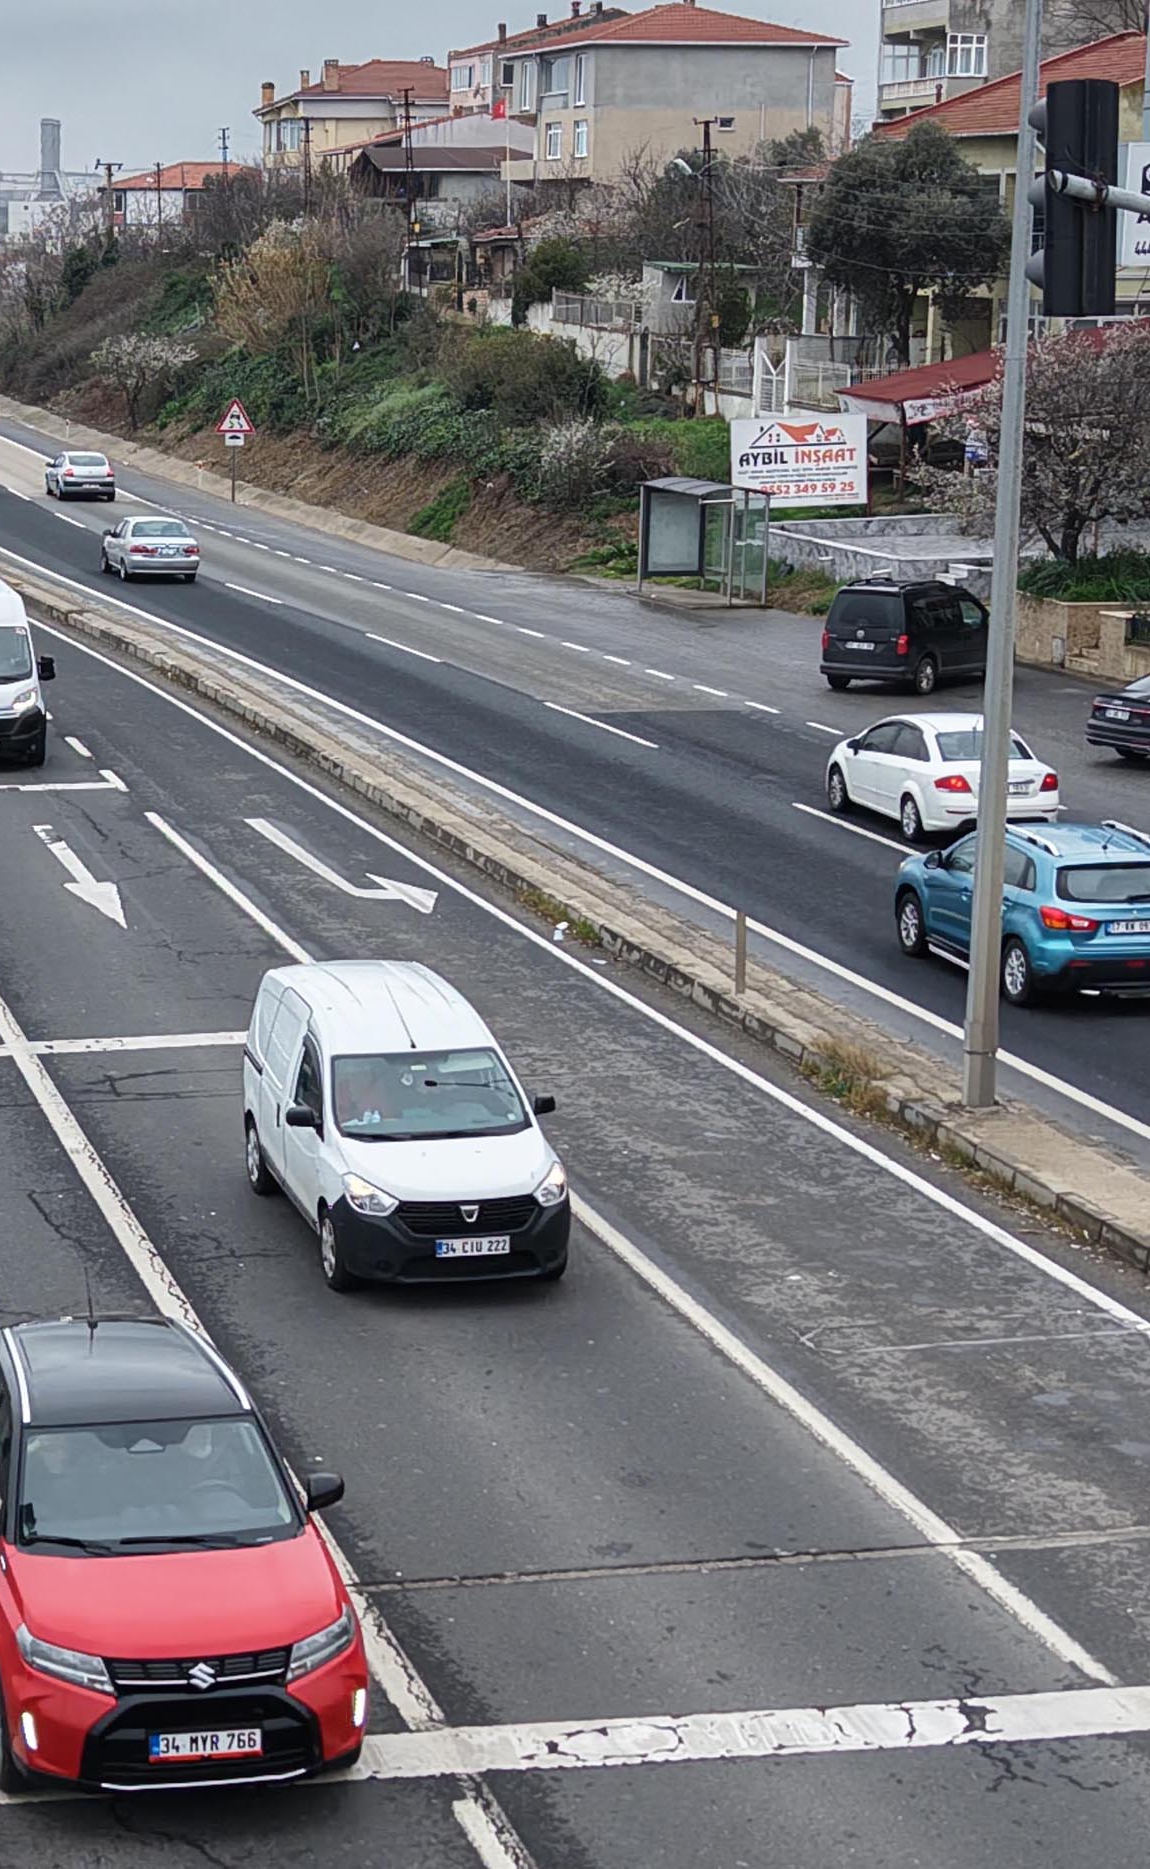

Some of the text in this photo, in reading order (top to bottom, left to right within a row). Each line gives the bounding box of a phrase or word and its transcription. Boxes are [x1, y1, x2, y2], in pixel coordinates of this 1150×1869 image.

[739, 448, 856, 467] AYBİL İNŞAAT
[794, 483, 818, 495] 349
[821, 482, 836, 493] 59
[840, 481, 855, 492] 25
[443, 1240, 508, 1255] 34 CIU 222
[161, 1731, 258, 1754] 34 MYR 766
